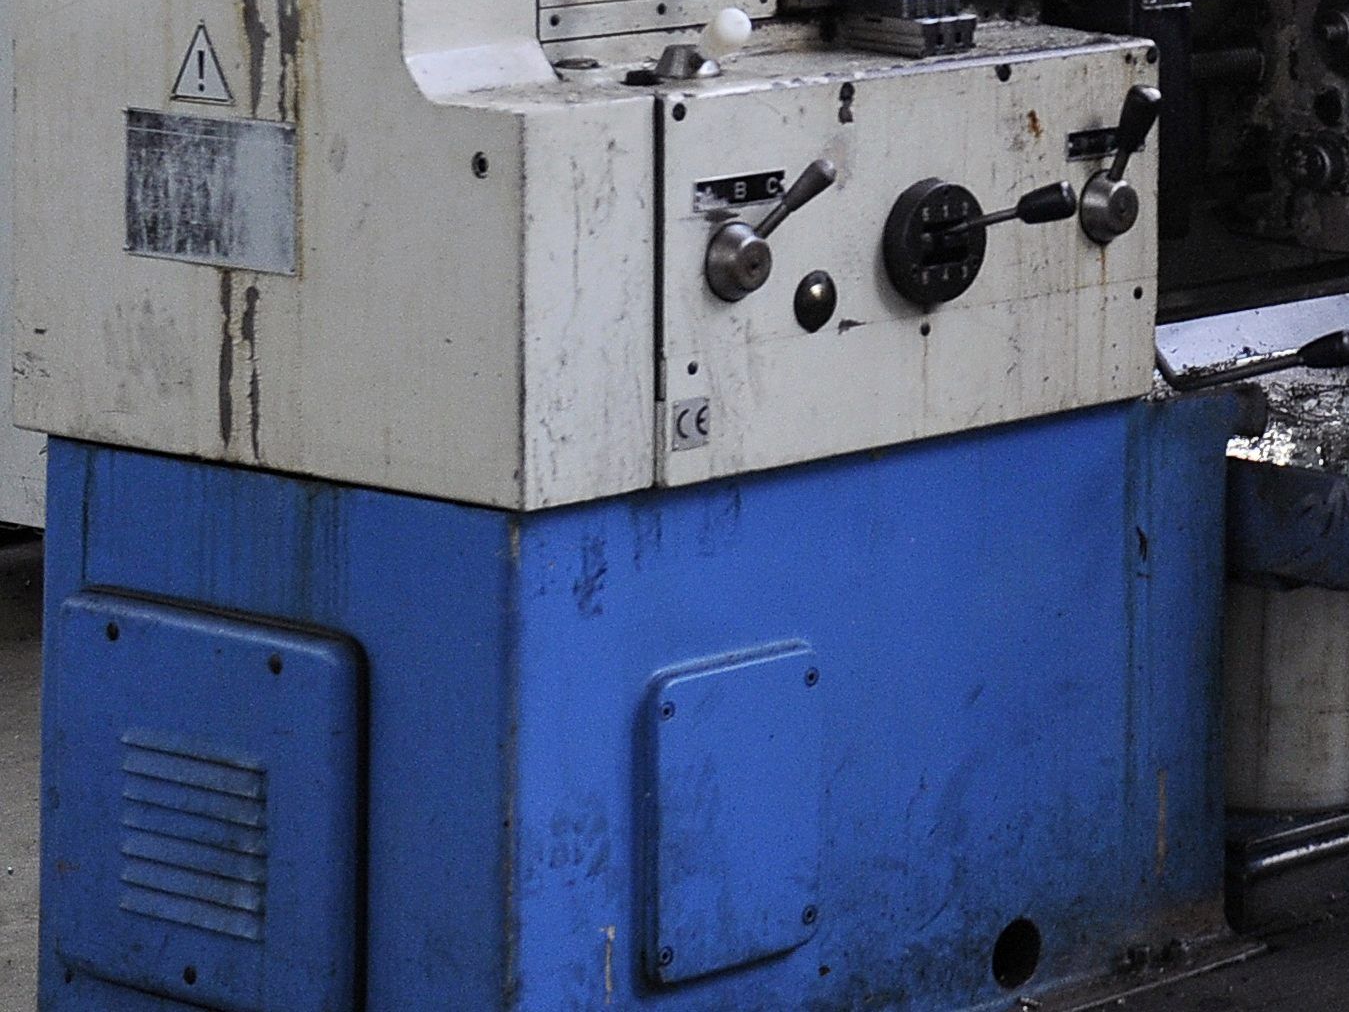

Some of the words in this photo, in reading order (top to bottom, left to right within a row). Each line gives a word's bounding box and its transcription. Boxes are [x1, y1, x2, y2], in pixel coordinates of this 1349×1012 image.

[734, 181, 748, 200] B
[765, 176, 779, 195] C
[676, 405, 708, 439] CE
